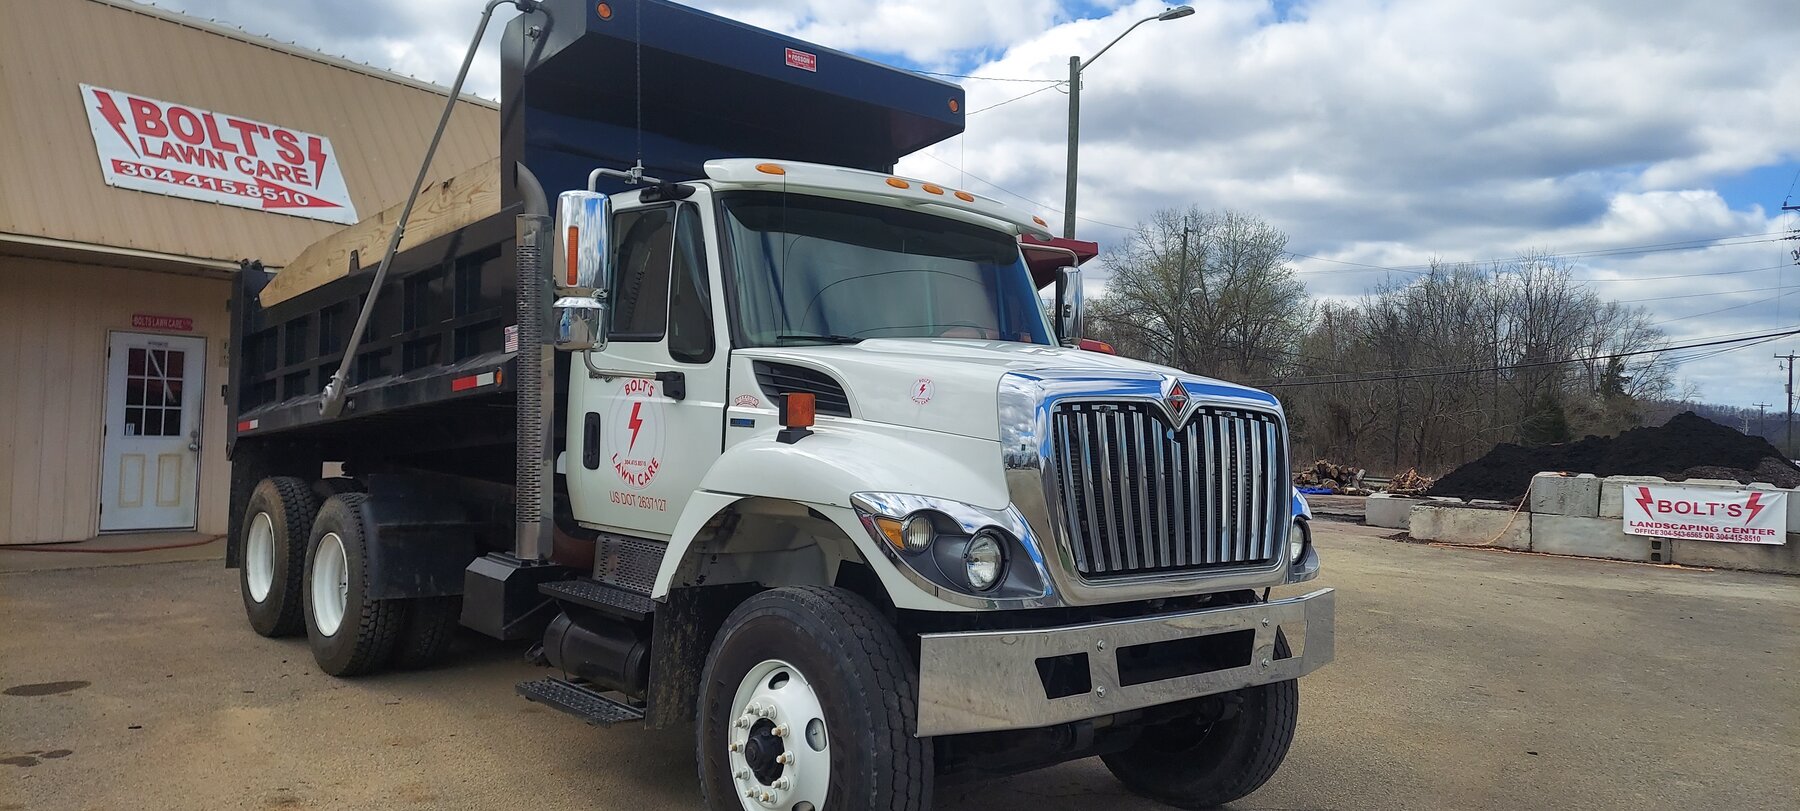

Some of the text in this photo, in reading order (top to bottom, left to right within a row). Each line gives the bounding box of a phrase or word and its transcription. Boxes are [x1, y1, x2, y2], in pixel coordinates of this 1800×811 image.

[127, 96, 305, 166] BOLT'S
[138, 136, 312, 188] LAWN CARE
[119, 160, 309, 207] 304.415.8510
[624, 379, 655, 397] BOLT'S
[612, 453, 658, 486] LAWN CARE
[610, 491, 666, 511] US DOT 2637127
[1629, 520, 1775, 536] LANDSCAPING CENTER
[1660, 530, 1703, 539] 304-543-6565
[1704, 532, 1715, 540] OR
[1716, 533, 1761, 542] 304-415-8510
